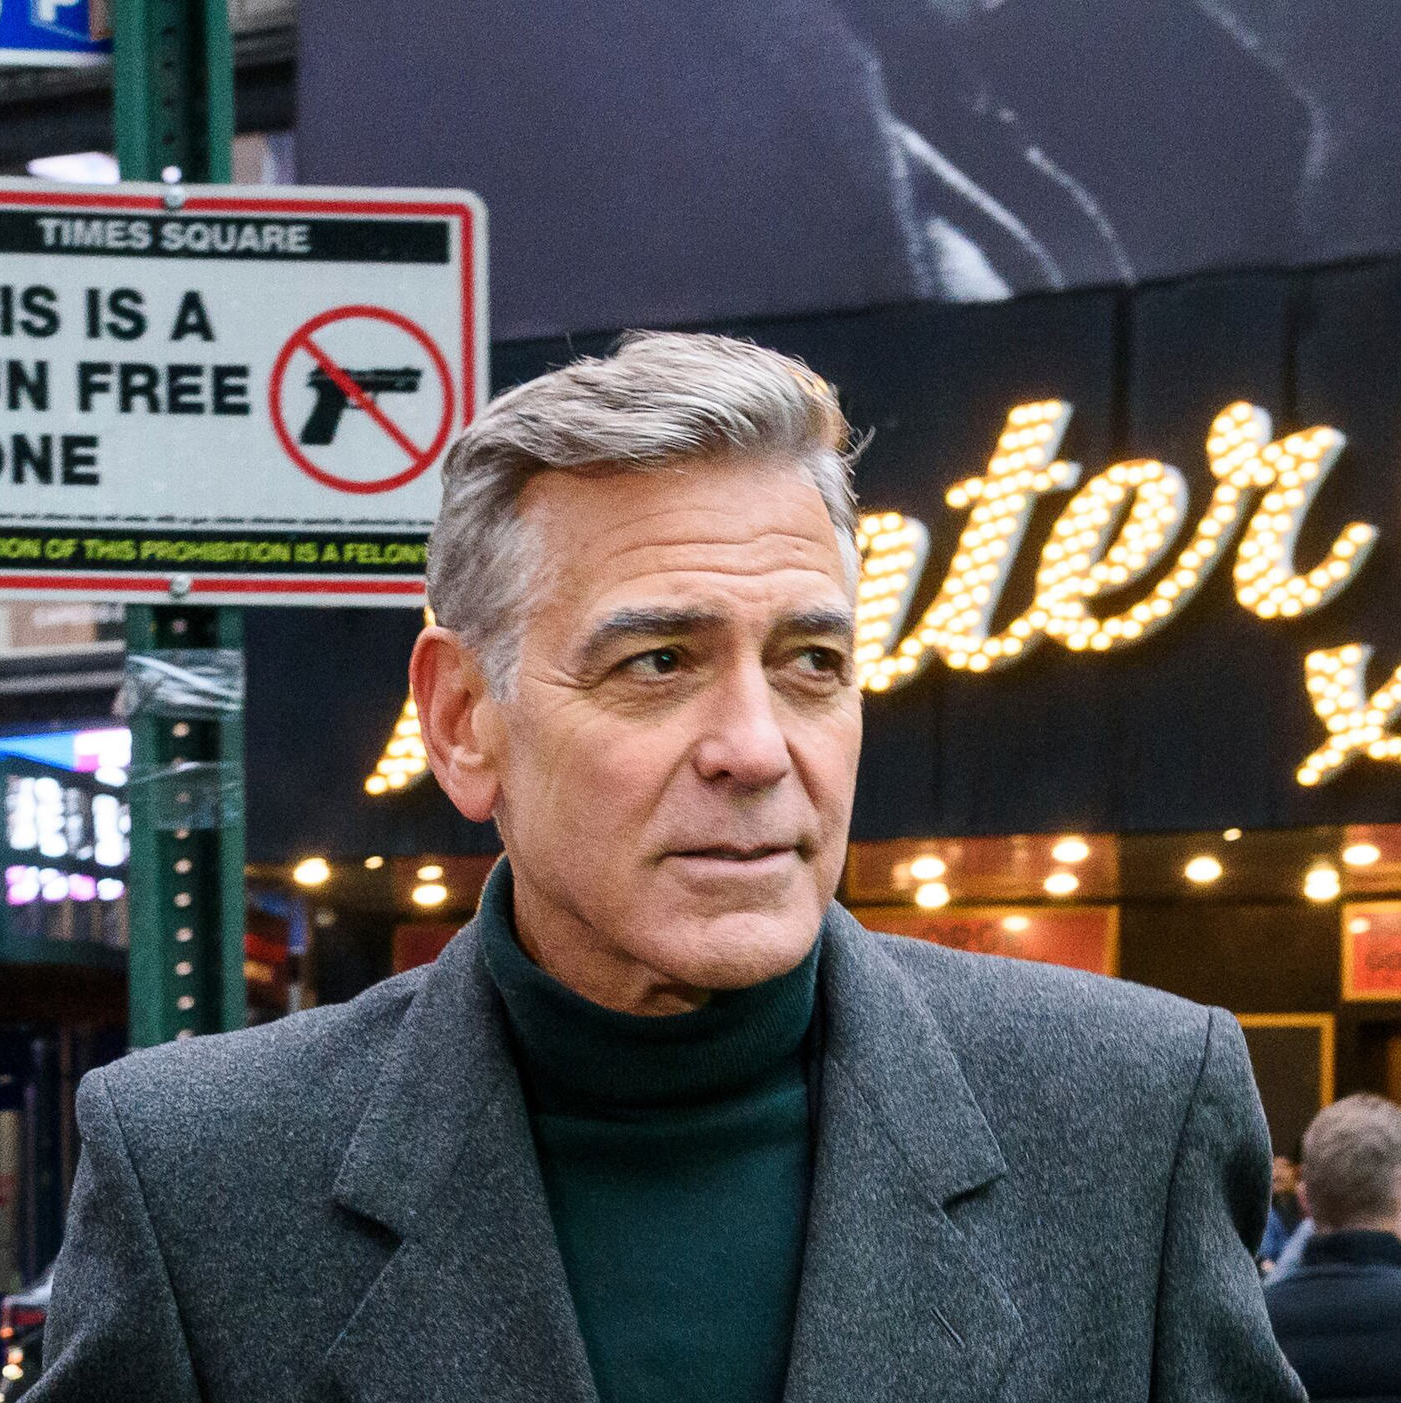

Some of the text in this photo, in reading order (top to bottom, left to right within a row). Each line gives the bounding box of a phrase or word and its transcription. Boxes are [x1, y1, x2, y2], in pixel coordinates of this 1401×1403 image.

[38, 217, 312, 253] TIMES SQUARE
[85, 287, 147, 341] IS
[169, 290, 216, 342] A
[77, 361, 251, 415] FREE
[44, 538, 78, 560] OF
[81, 539, 137, 561] THIS
[139, 540, 292, 563] PROHIBITION
[294, 542, 319, 563] IS
[320, 543, 341, 563] A
